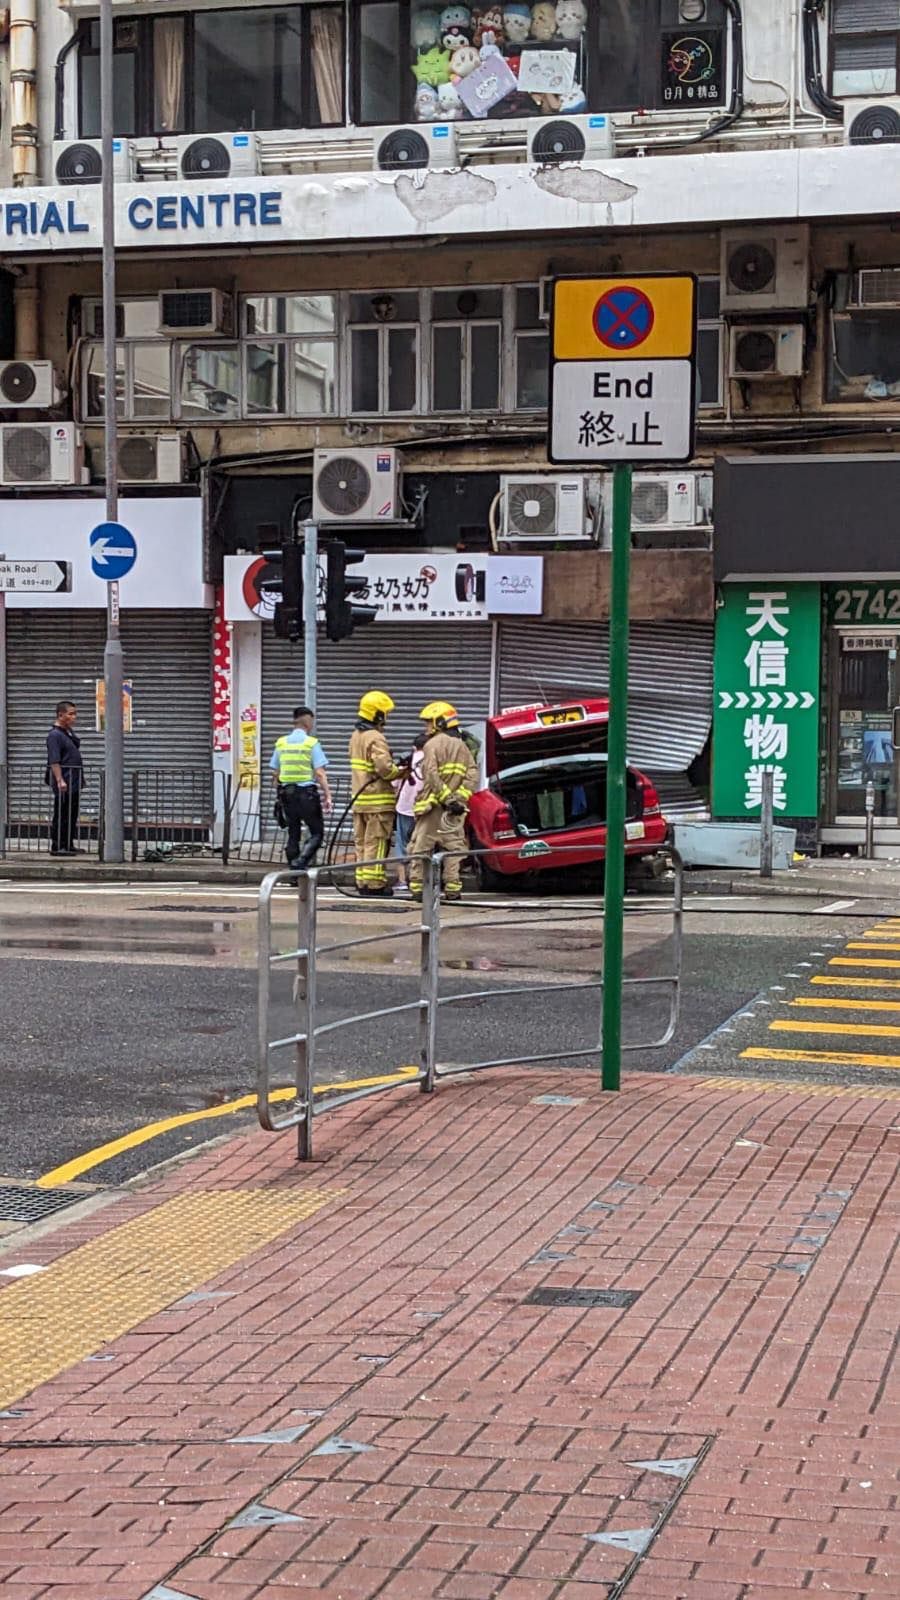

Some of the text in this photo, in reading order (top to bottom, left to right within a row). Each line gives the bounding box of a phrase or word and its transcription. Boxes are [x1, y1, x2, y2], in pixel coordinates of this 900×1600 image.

[128, 192, 282, 230] CENTRE
[593, 372, 653, 398] End
[578, 410, 663, 447] 終止
[0, 565, 37, 573] ak Road
[834, 589, 900, 620] 2742
